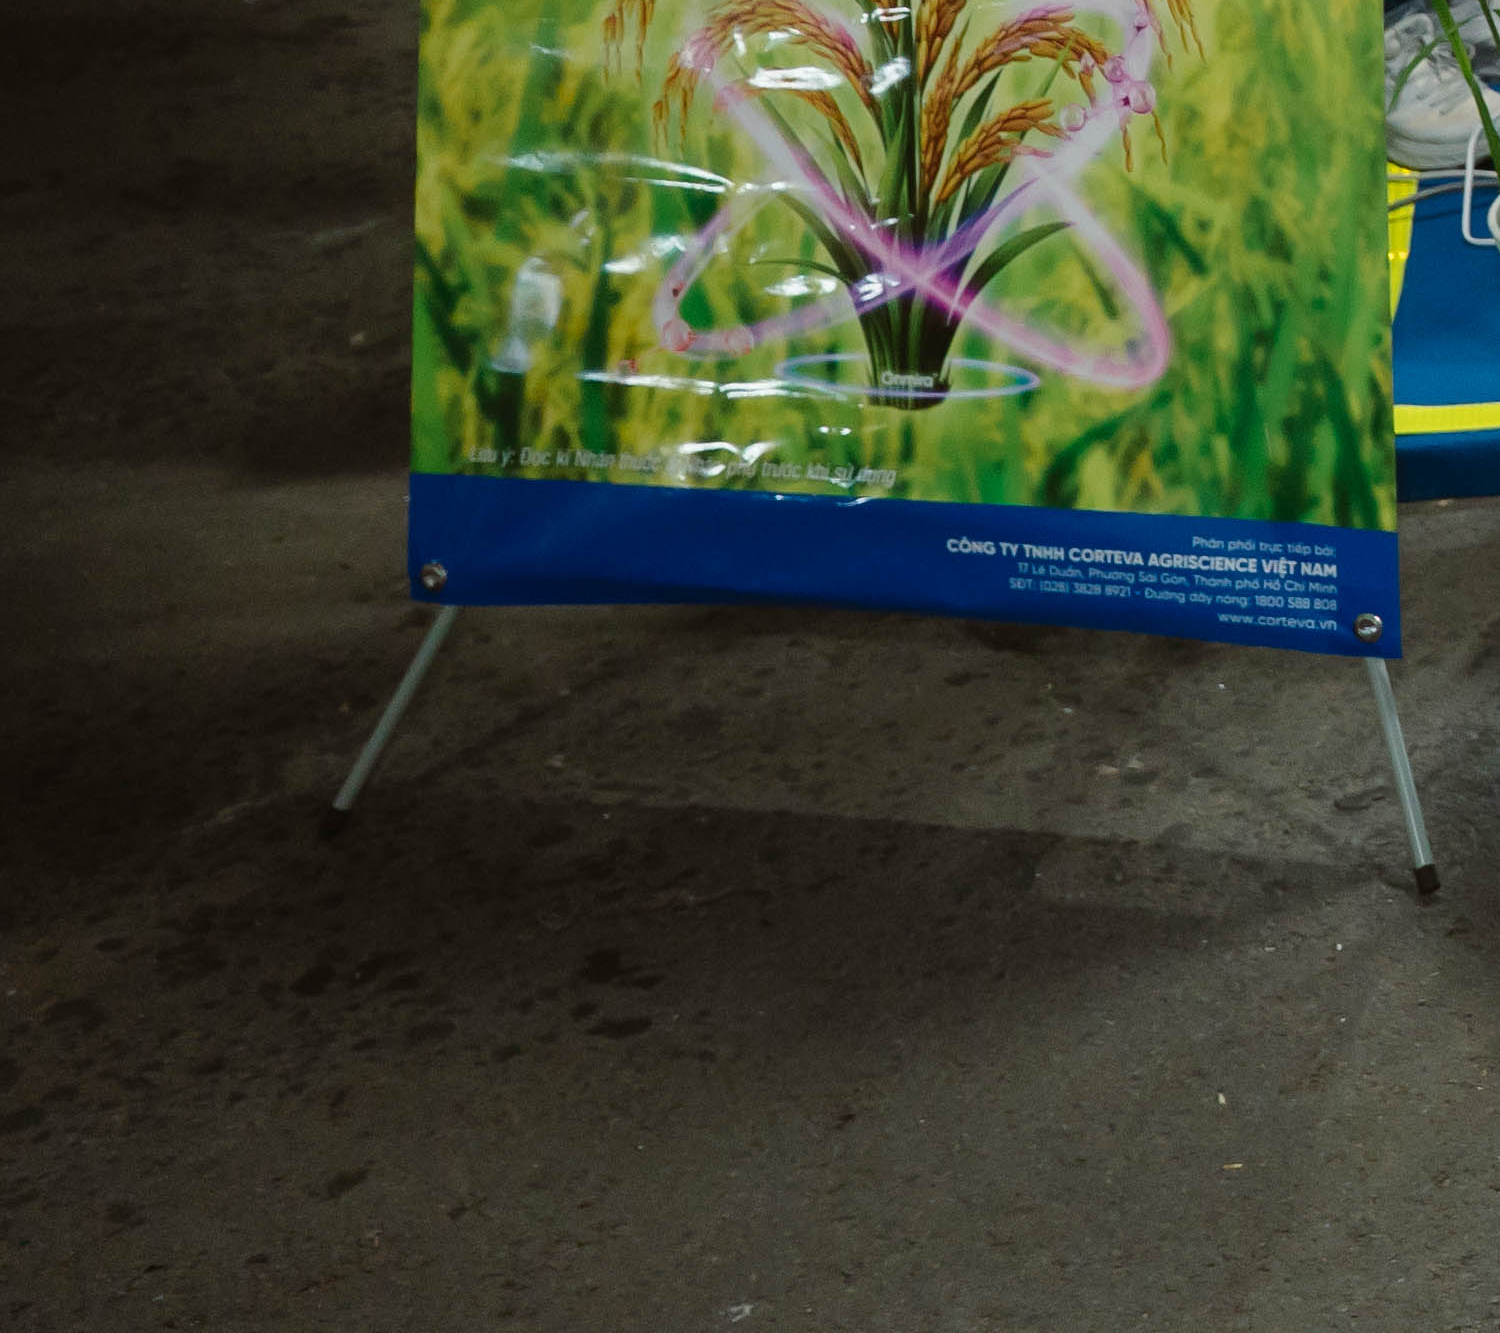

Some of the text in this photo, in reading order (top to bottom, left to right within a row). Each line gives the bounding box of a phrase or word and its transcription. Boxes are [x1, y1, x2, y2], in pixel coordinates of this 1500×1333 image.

[947, 538, 1337, 581] CÔNG TY TNHH CORTEVA AGRISCIENCE VIỆT NAM
[1218, 612, 1337, 631] www.corteva.vn
